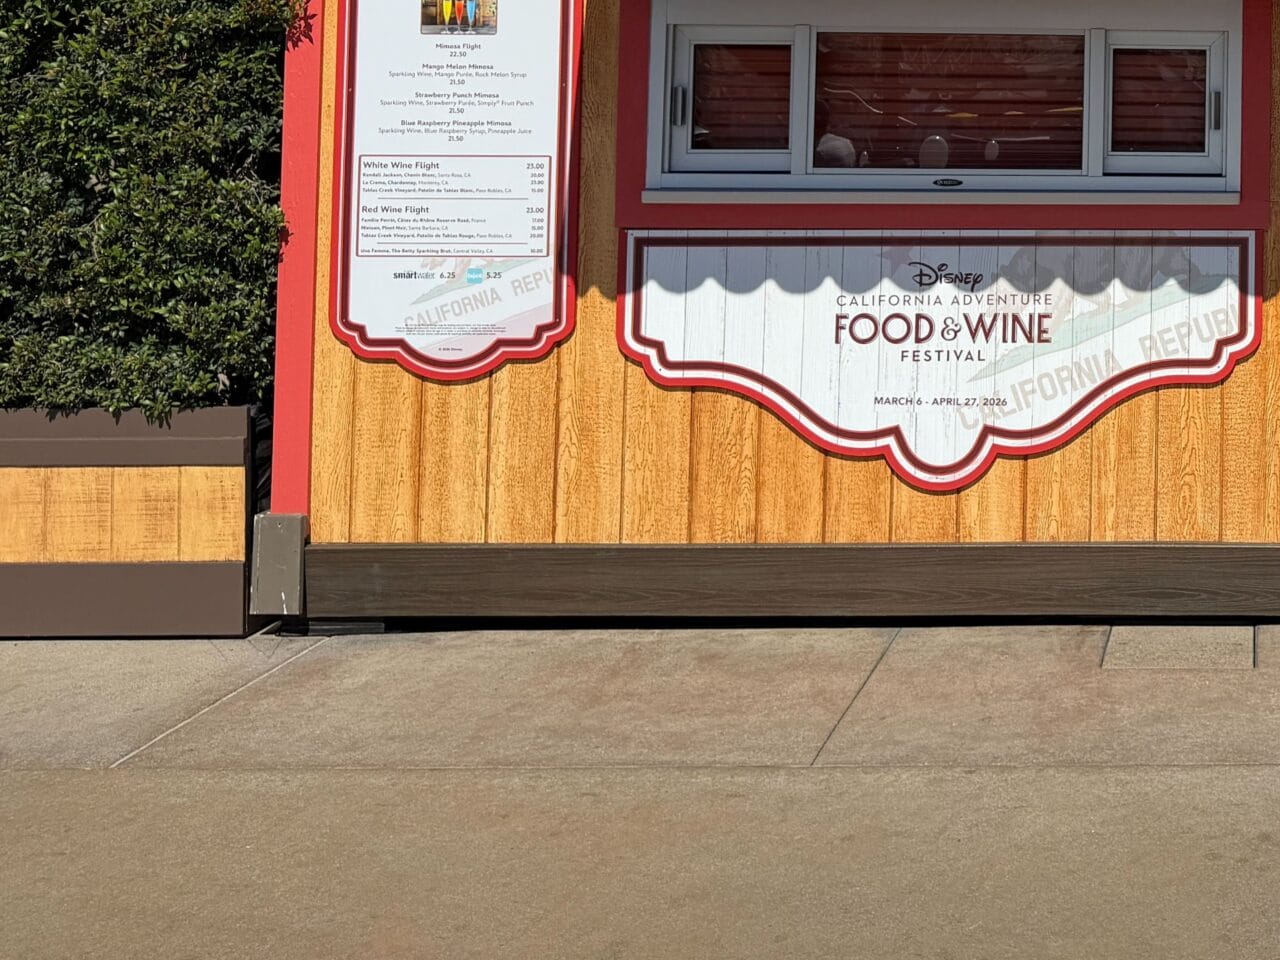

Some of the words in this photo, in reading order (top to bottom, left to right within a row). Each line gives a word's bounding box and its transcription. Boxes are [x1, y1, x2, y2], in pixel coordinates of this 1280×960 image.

[462, 43, 481, 51] Flight
[363, 161, 388, 169] White
[391, 161, 412, 169] Wine
[415, 162, 439, 171] Flight
[362, 205, 378, 213] Red
[405, 206, 429, 215] Flight
[439, 271, 456, 279] 6.25
[486, 271, 502, 279] 5.25
[908, 262, 984, 292] Disney
[836, 294, 943, 307] CALIFORNIA
[951, 293, 1053, 306] ADVENTURE
[834, 312, 934, 345] FOOD
[940, 316, 962, 342] &
[962, 312, 1053, 344] WINE
[900, 349, 986, 362] FESTIVAL
[955, 348, 1121, 431] CALIFORNIA
[874, 396, 913, 406] MARCH
[916, 397, 922, 406] 6
[931, 397, 962, 406] APRIL
[964, 398, 979, 407] 27,
[983, 397, 1007, 406] 2026
